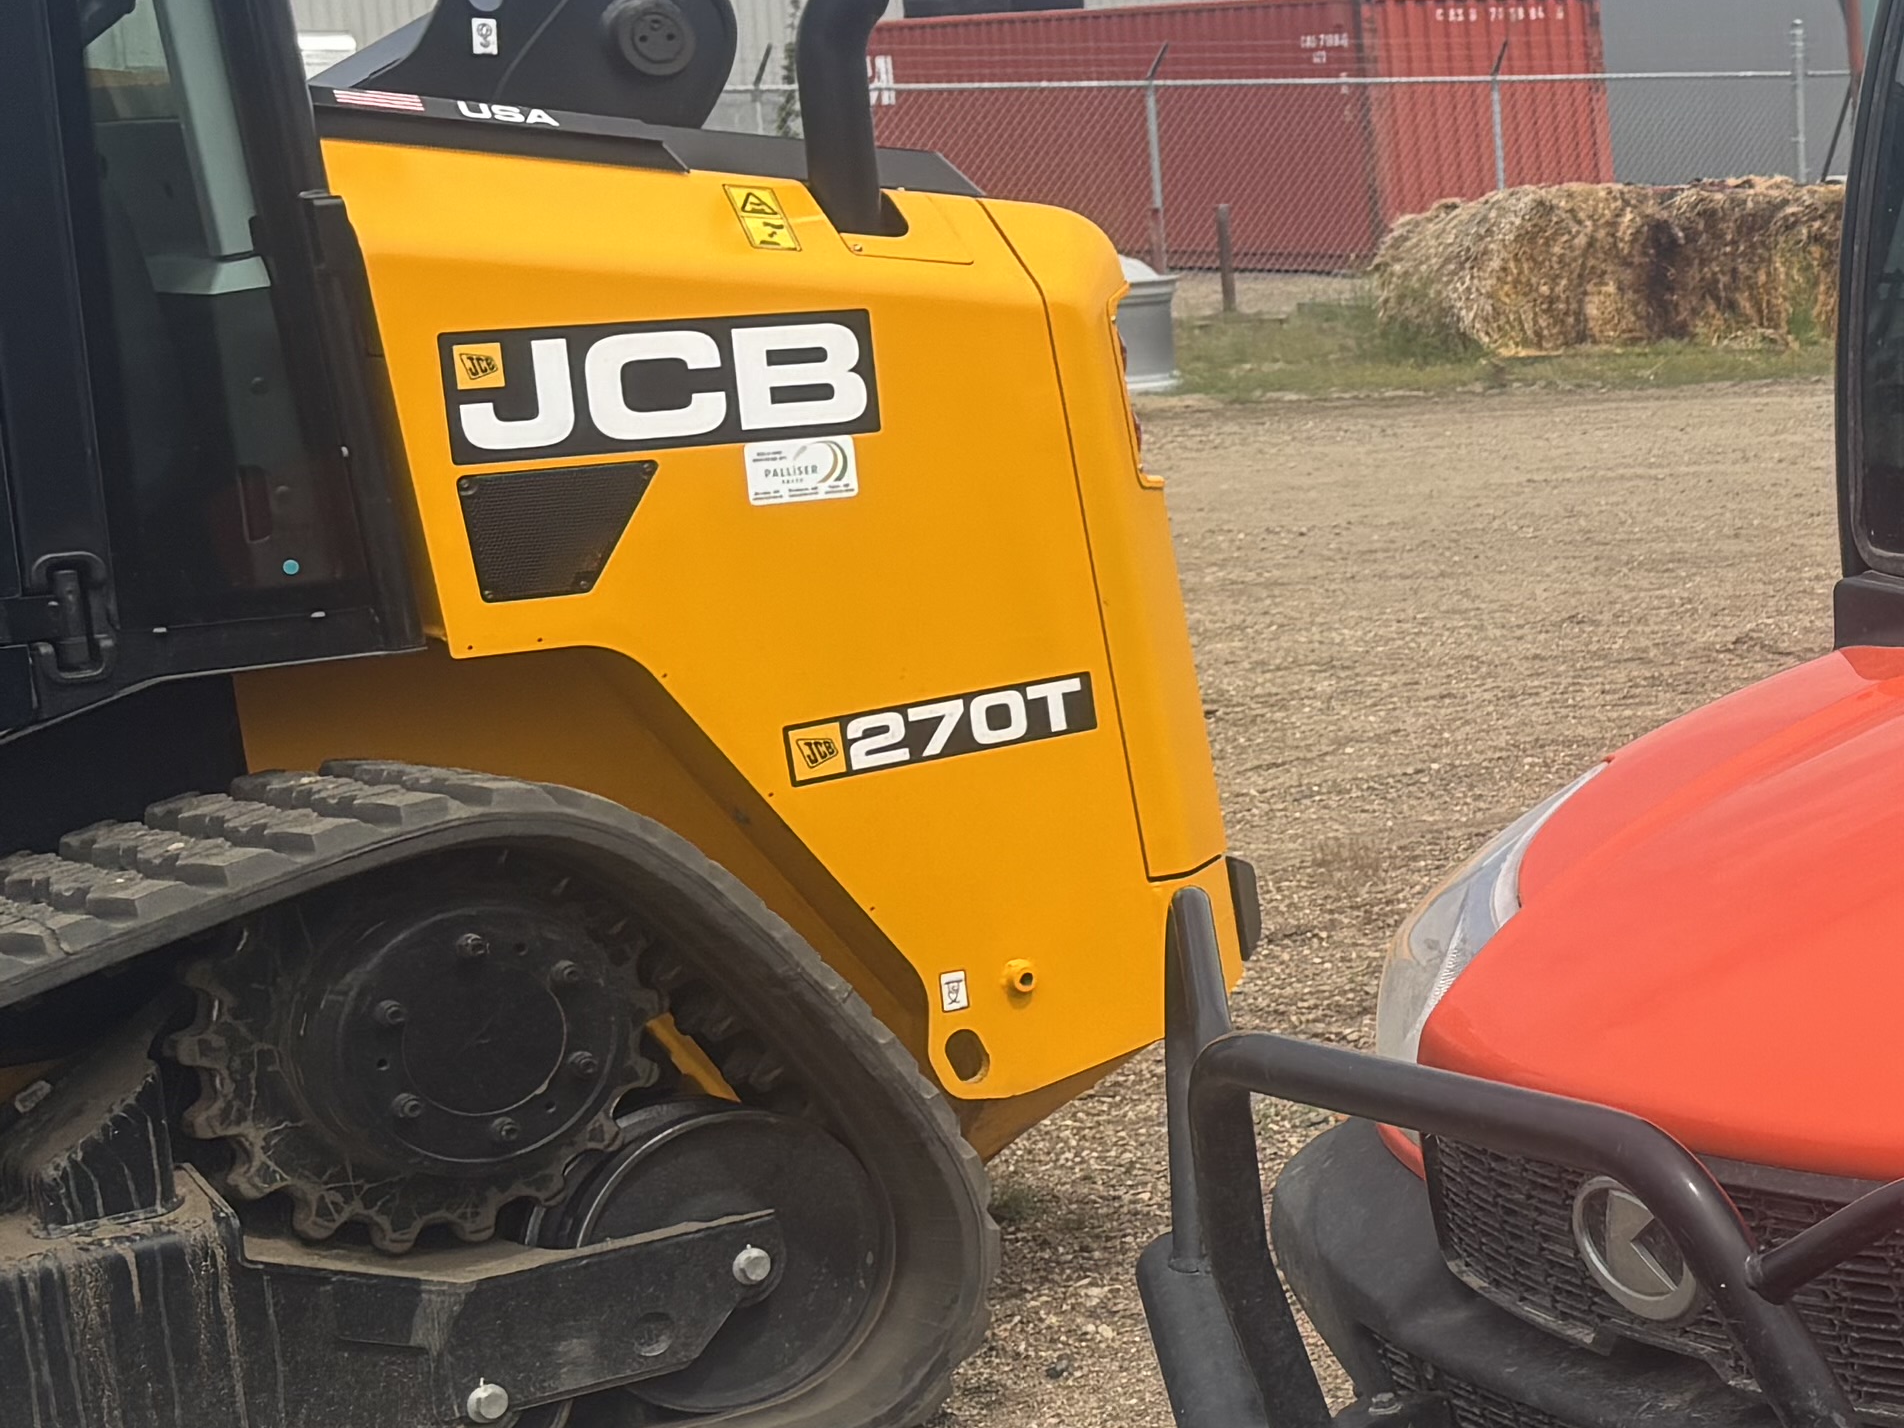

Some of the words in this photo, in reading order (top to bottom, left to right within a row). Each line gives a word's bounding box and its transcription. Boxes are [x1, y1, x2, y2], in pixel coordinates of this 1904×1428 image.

[457, 100, 560, 126] USA
[466, 356, 498, 377] JCB
[459, 323, 868, 450] JCB
[846, 677, 1082, 771] 270T
[804, 740, 835, 765] JCB
